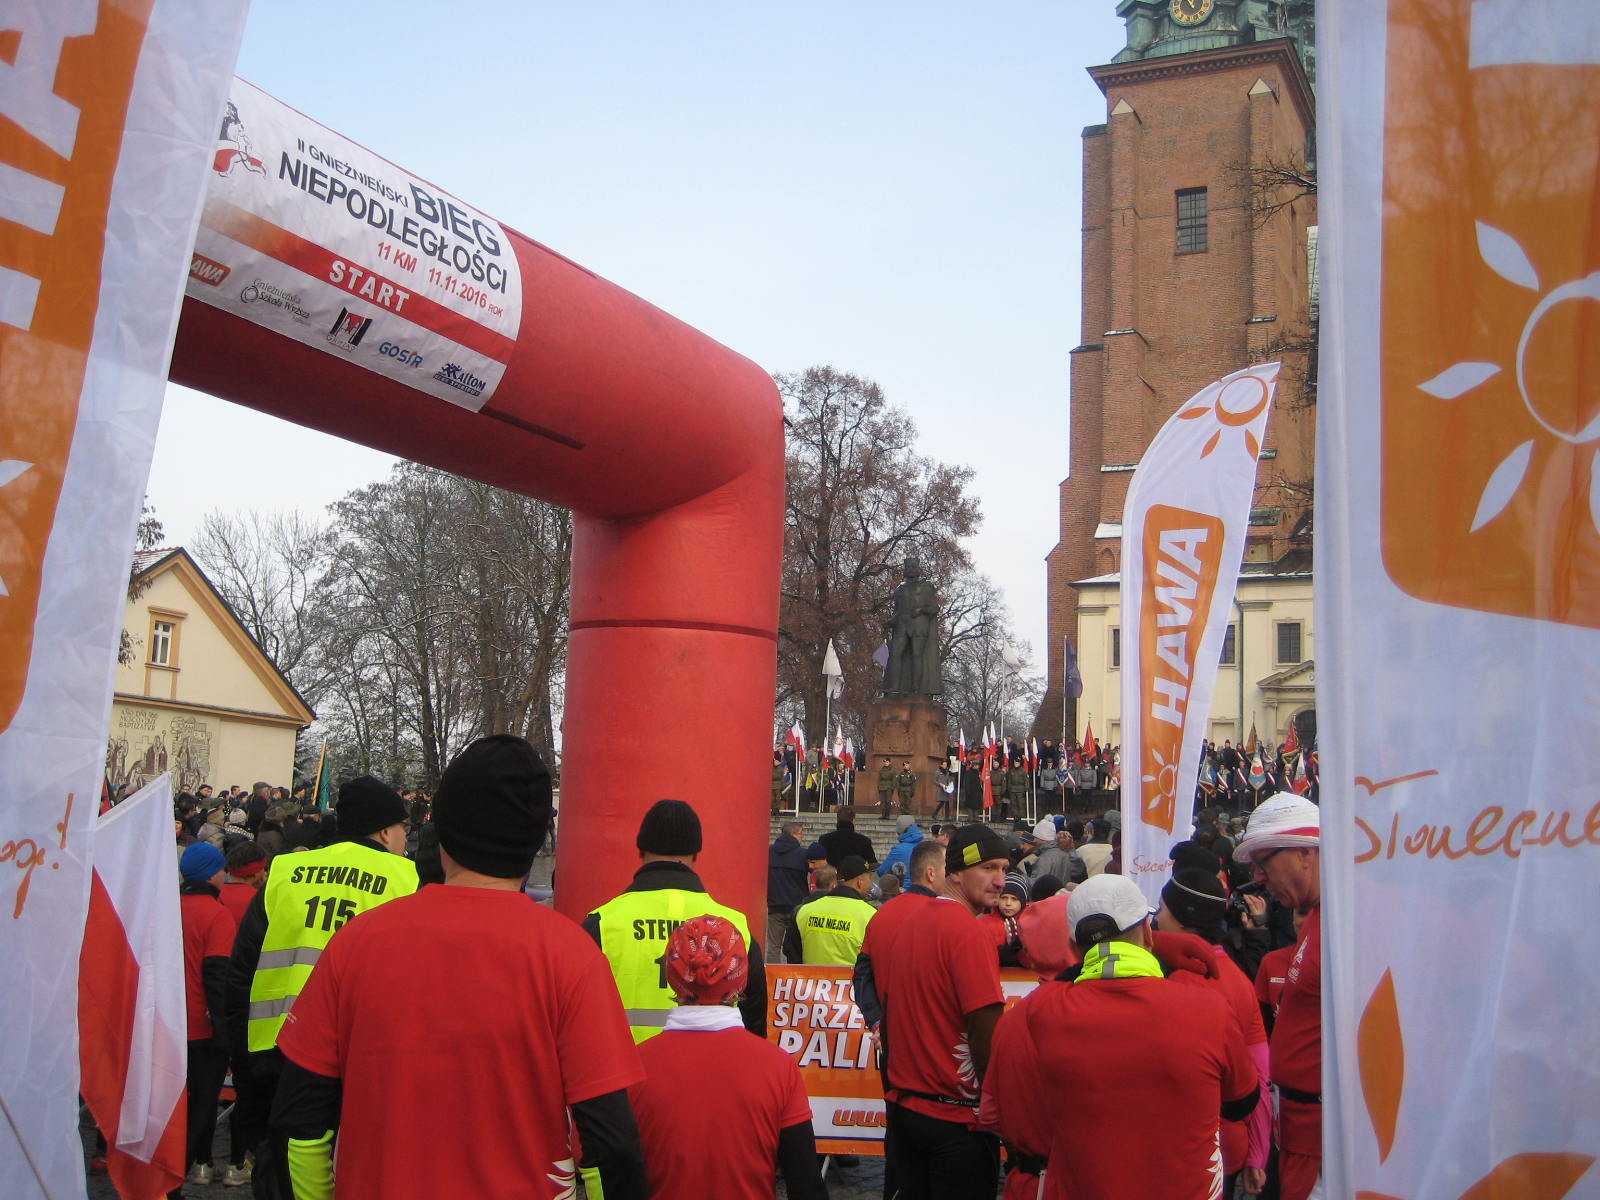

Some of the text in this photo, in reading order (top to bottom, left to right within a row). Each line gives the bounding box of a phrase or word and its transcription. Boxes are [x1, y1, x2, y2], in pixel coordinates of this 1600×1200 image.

[297, 137, 305, 153] II
[408, 182, 501, 257] BIEG
[279, 151, 508, 294] NIEPODLEGŁOŚCI
[191, 259, 225, 283] AWA
[329, 260, 411, 313] START
[377, 241, 504, 318] 11 KM 11.11.2016 ROK
[1151, 528, 1208, 729] HAWA
[291, 865, 388, 896] STEWARD
[304, 895, 358, 932] 115
[654, 954, 668, 989] 1
[773, 978, 856, 1003] HURT
[773, 1002, 869, 1030] SPRZE
[778, 1029, 881, 1070] PALI
